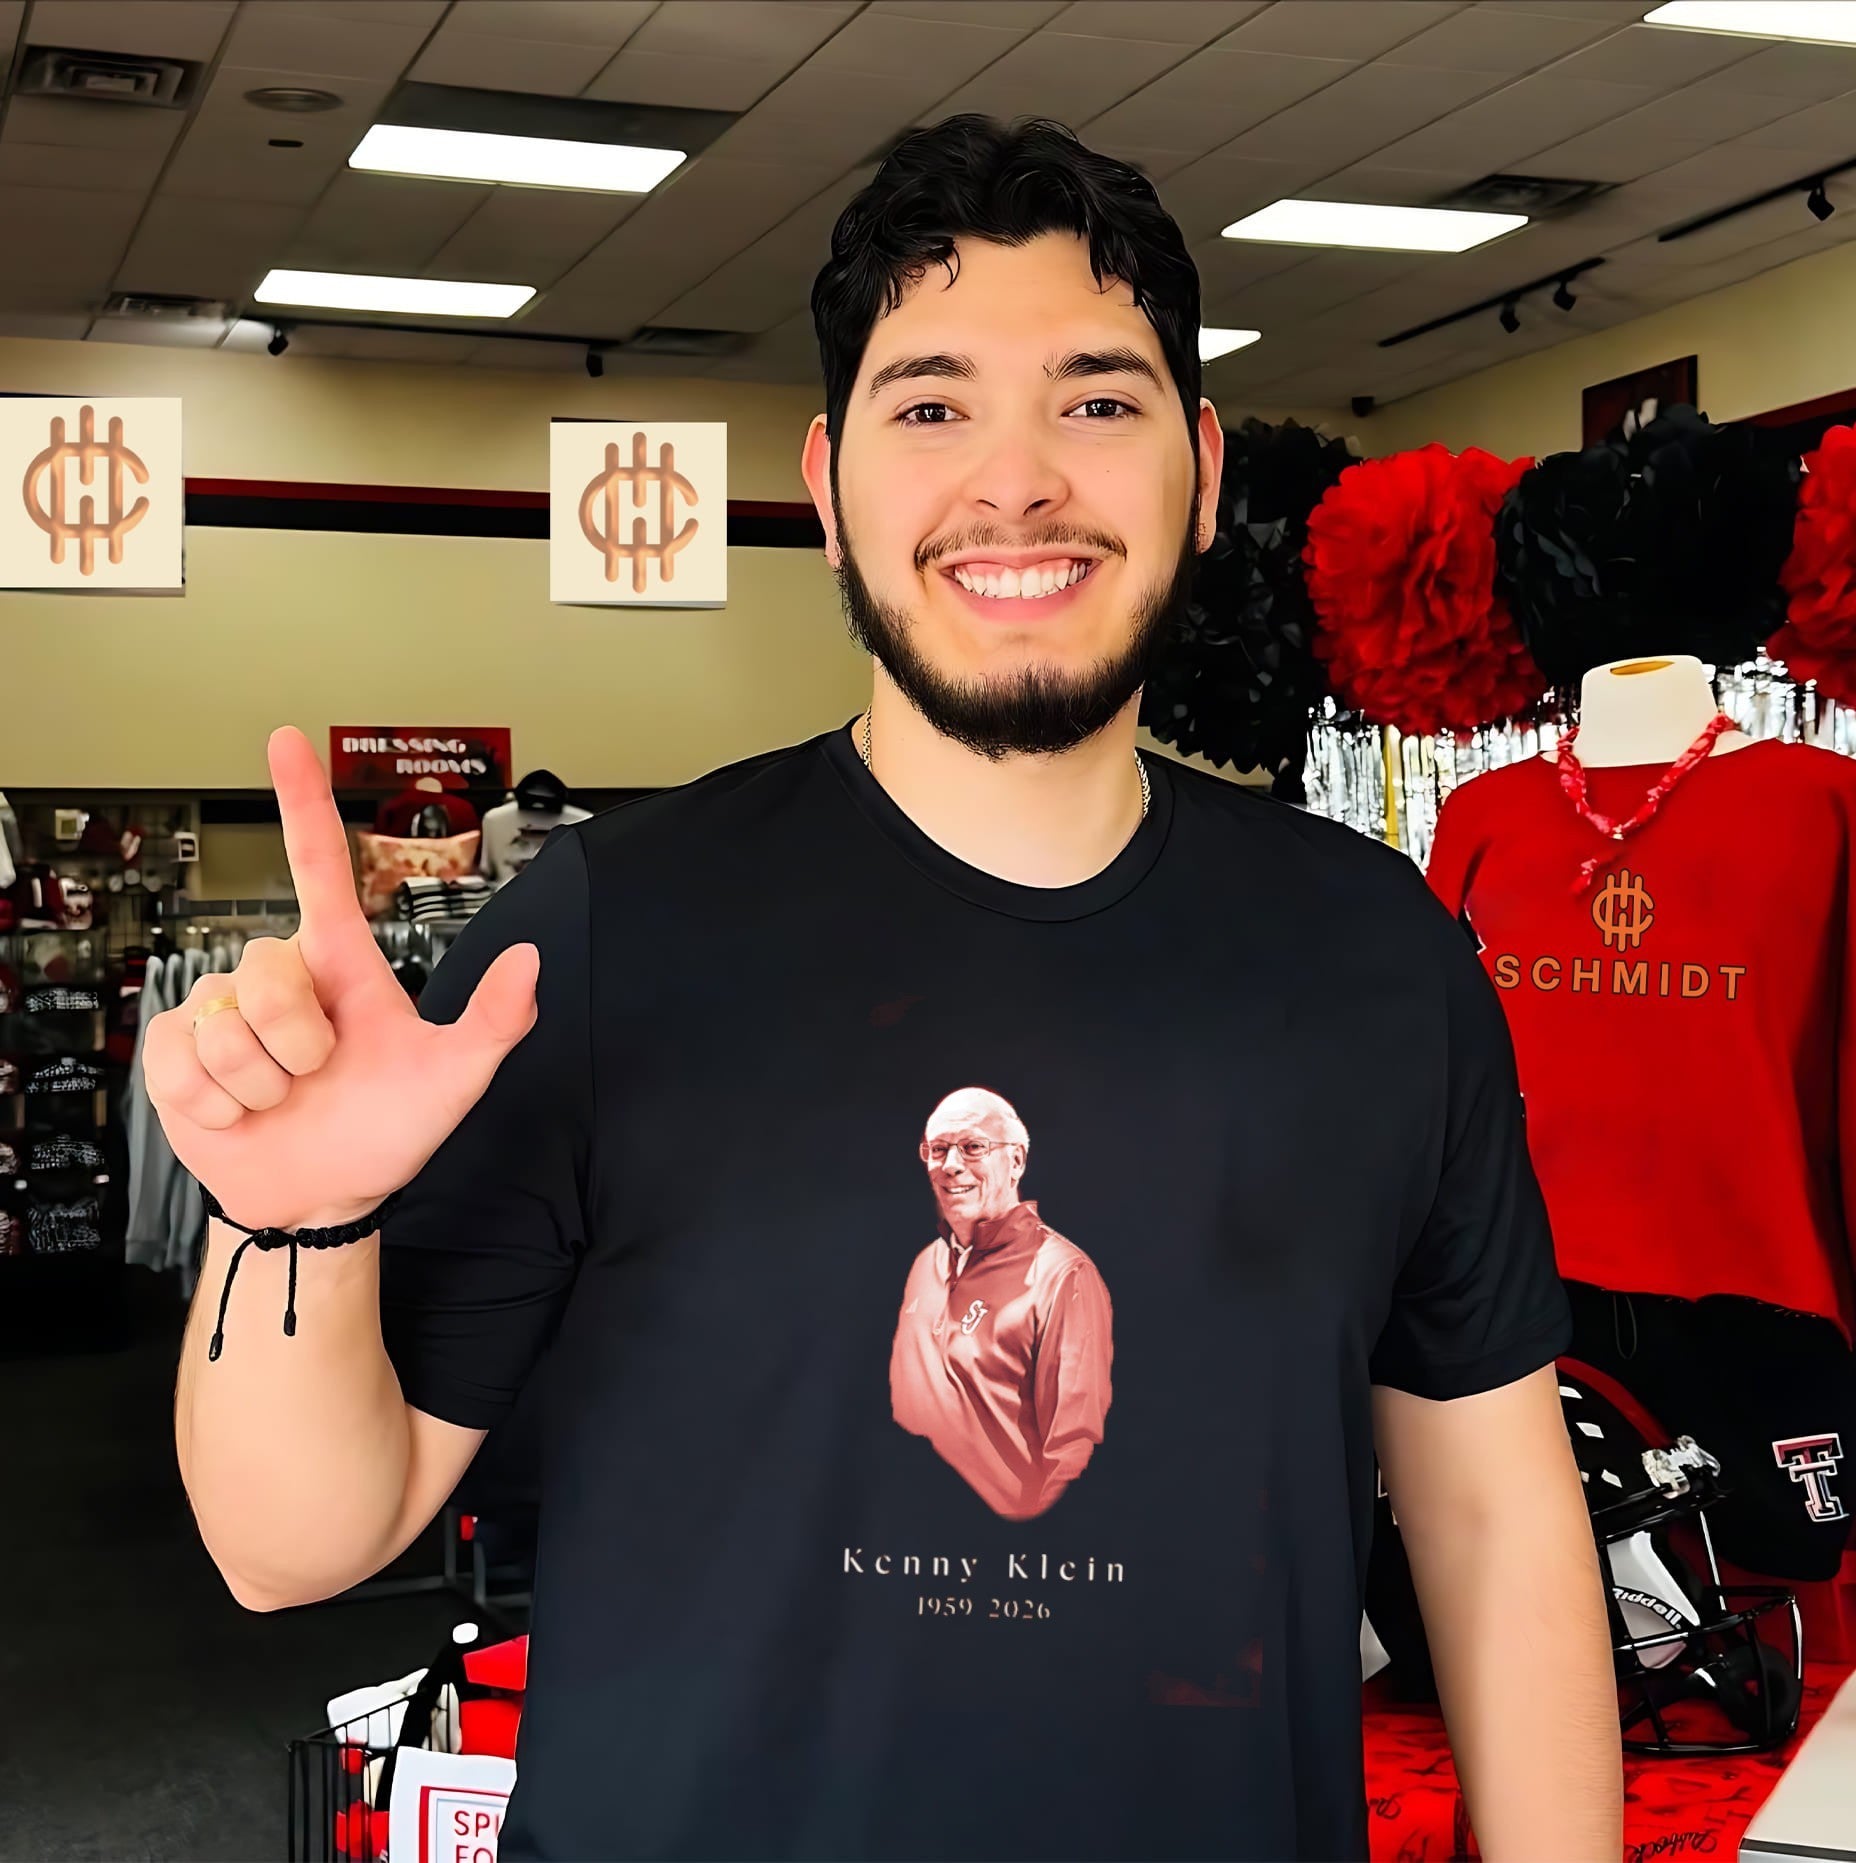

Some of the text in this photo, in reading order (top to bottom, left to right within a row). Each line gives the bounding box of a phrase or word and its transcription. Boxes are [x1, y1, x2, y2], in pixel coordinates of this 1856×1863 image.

[342, 737, 466, 753] DRESSING
[396, 758, 487, 775] ROOMS
[1494, 953, 1747, 1000] SCHMIDT
[843, 1547, 1124, 1583] Kenny Klein
[918, 1597, 1050, 1619] 1959 2026
